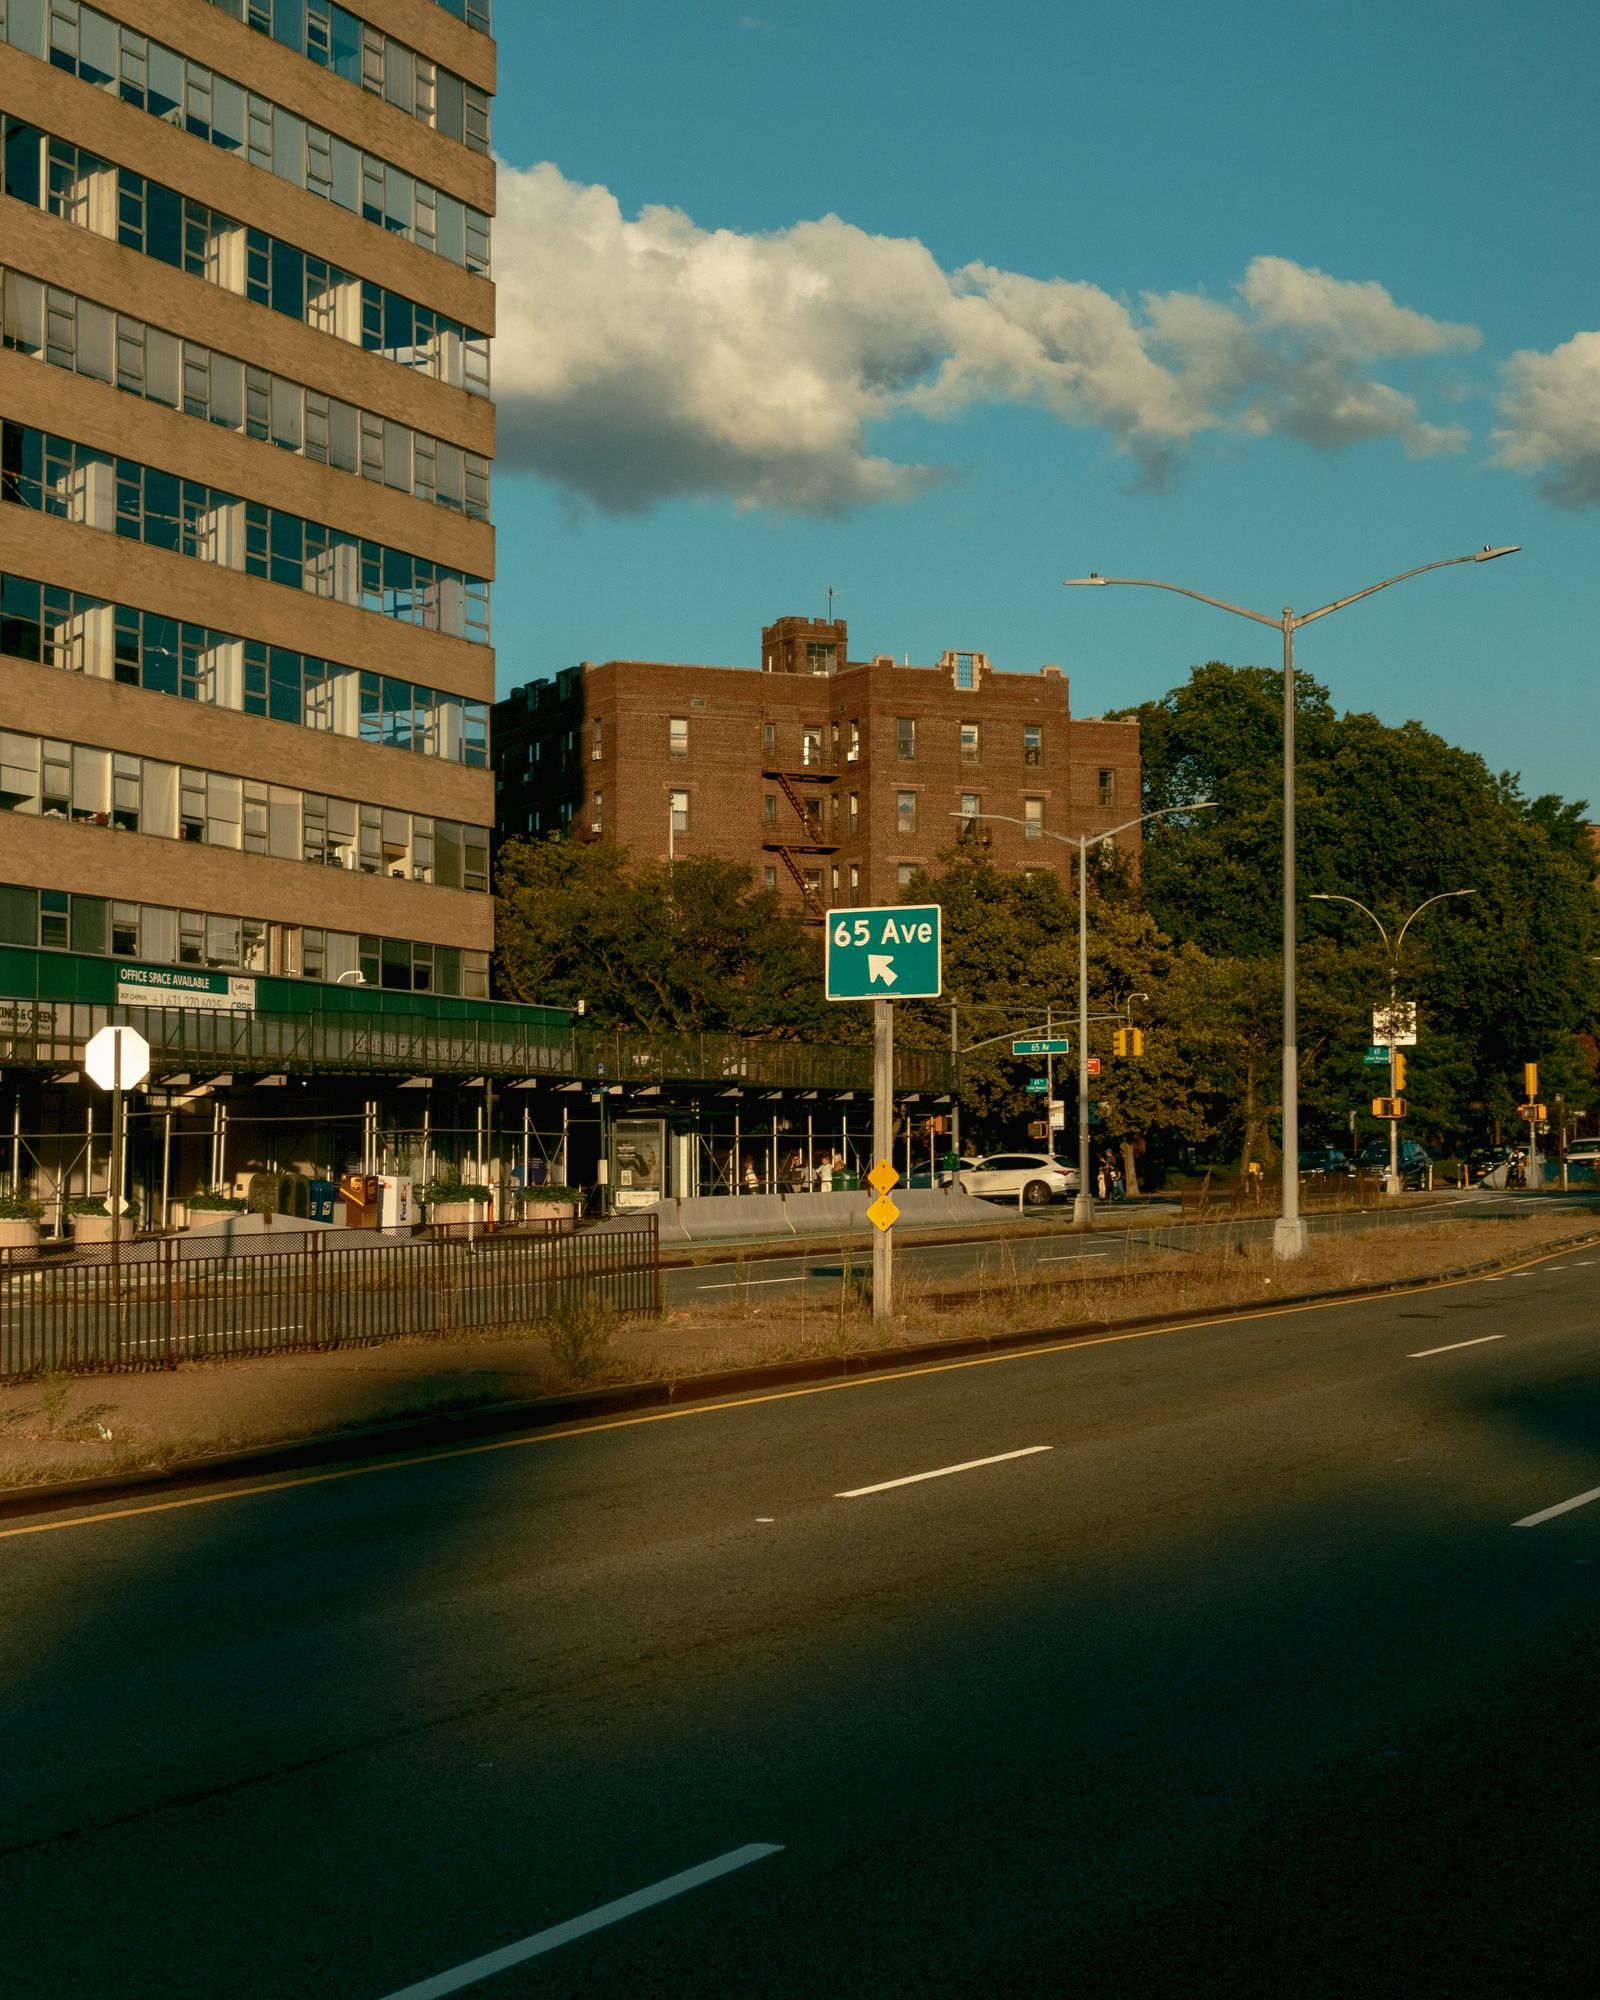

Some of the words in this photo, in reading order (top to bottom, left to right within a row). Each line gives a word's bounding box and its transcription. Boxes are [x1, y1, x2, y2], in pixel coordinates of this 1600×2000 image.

[834, 919, 871, 948] 65
[880, 918, 933, 945] Ave
[120, 968, 148, 983] OFFICE
[148, 971, 172, 986] SPACE
[172, 974, 210, 989] AVAILABLE
[27, 1009, 58, 1024] QEENS
[1031, 1043, 1040, 1051] 65
[1041, 1043, 1050, 1051] Av
[400, 1183, 408, 1221] FedEx
